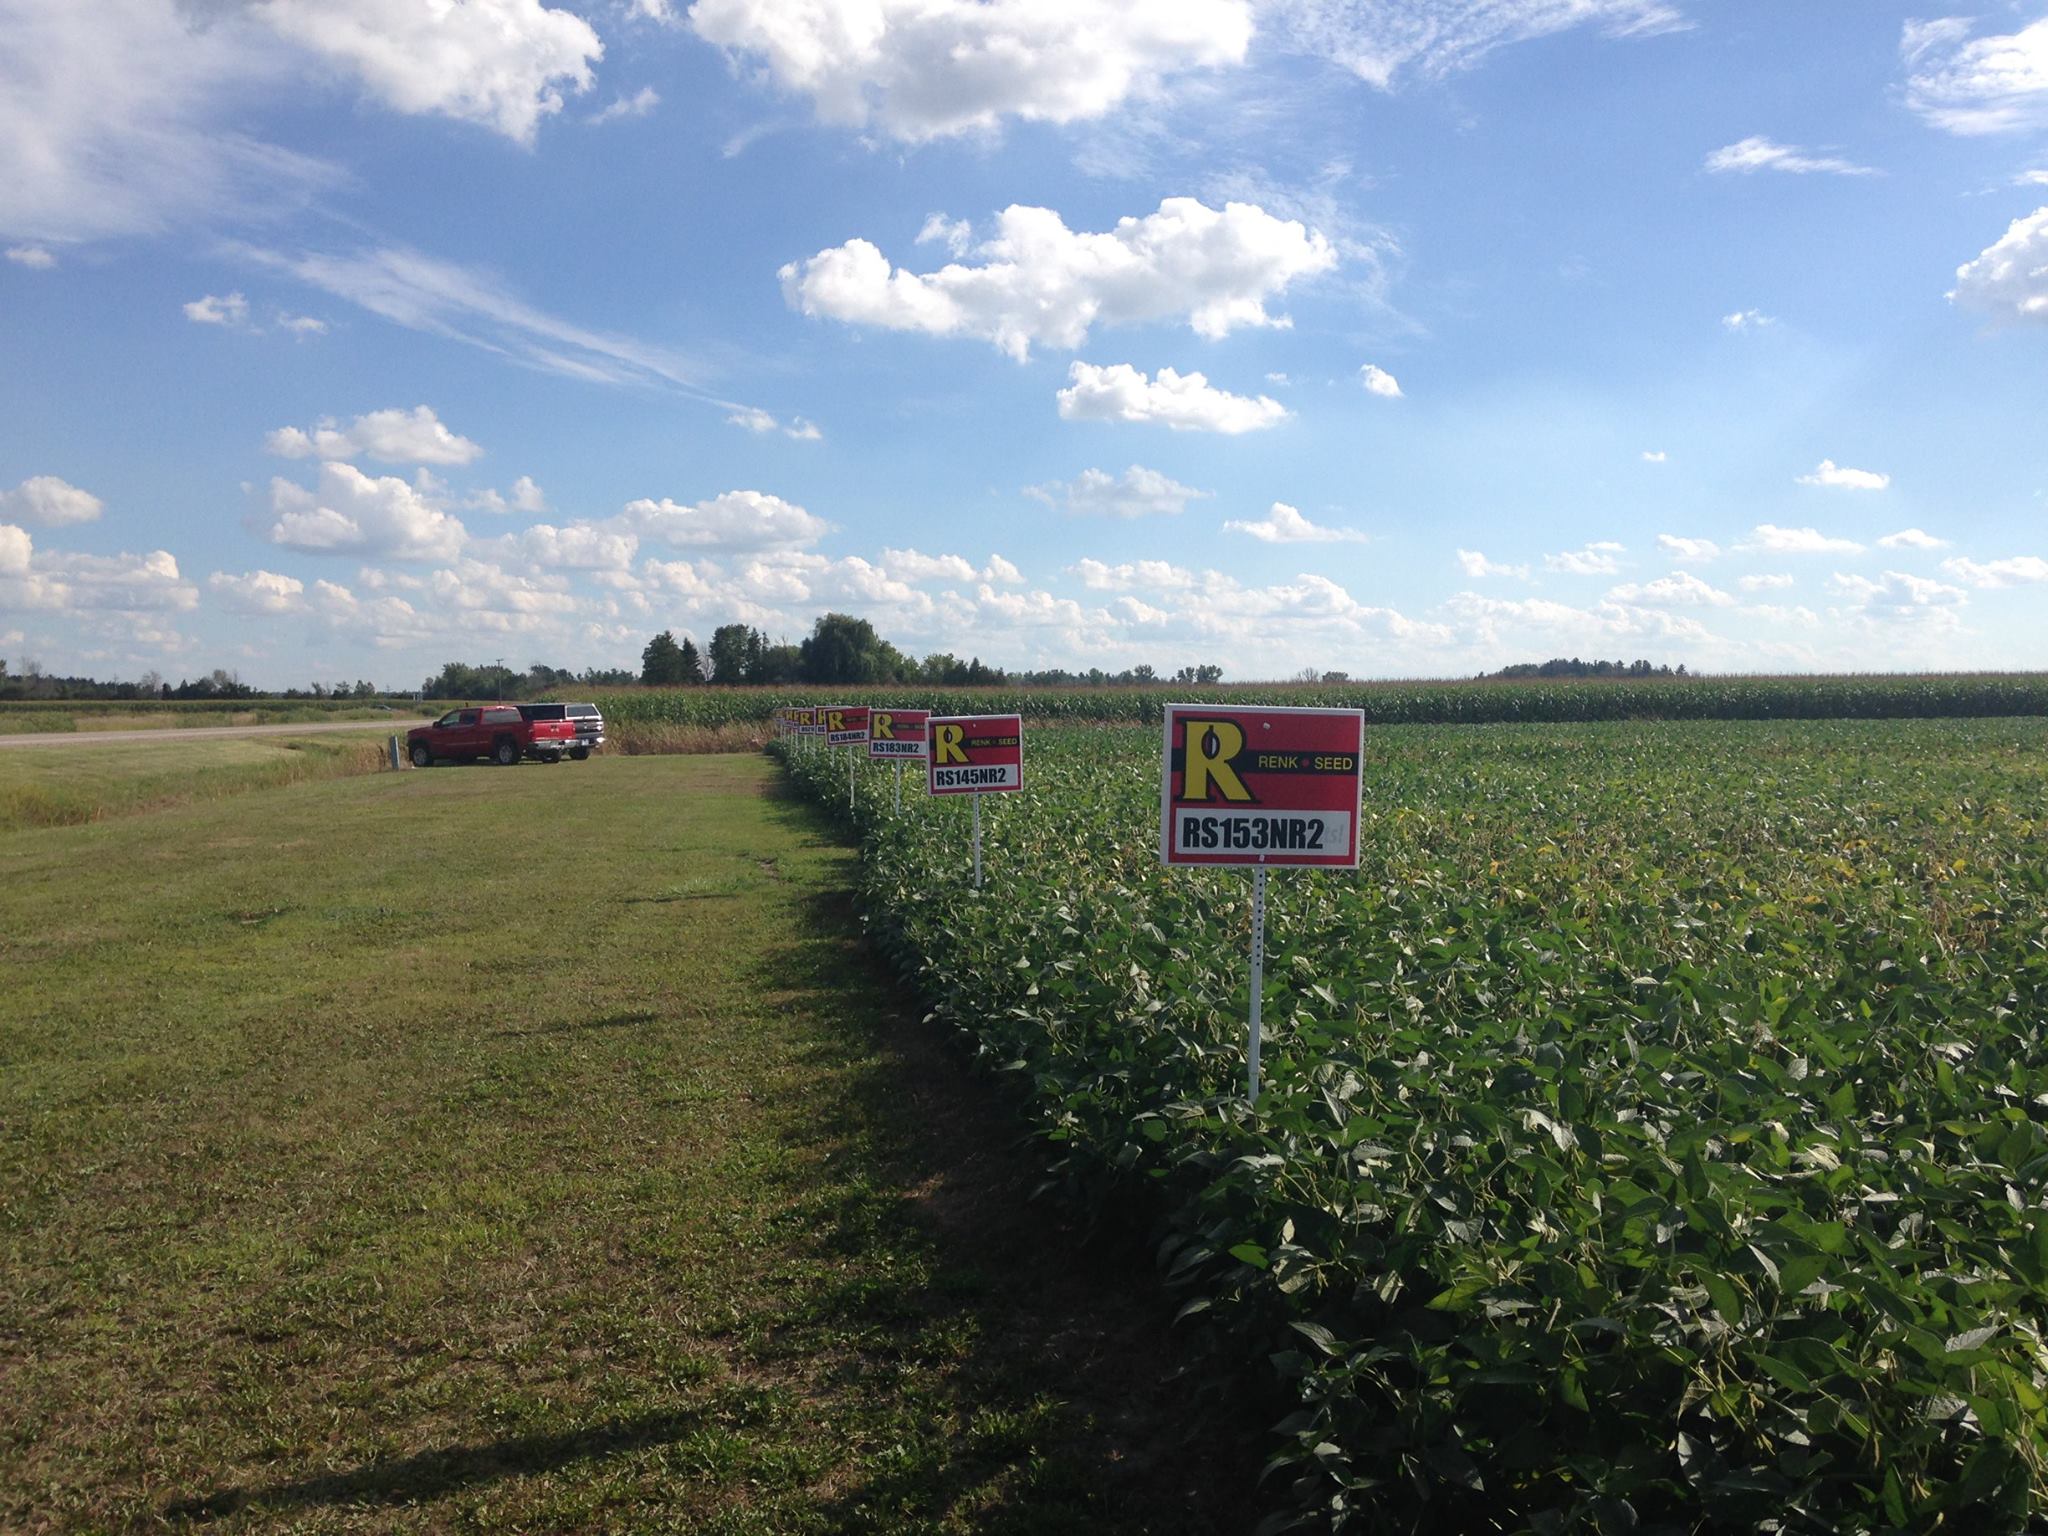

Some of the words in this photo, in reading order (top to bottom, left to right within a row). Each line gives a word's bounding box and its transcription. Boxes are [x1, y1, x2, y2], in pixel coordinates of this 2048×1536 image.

[828, 711, 846, 731] R
[872, 713, 895, 738] R
[872, 742, 919, 753] RS183NR2
[935, 724, 970, 764] R
[1181, 719, 1254, 802] R
[1257, 755, 1298, 769] RENK
[1313, 757, 1353, 770] SEED
[936, 767, 1006, 786] RS145NR2
[1182, 816, 1325, 850] RS153NR2
